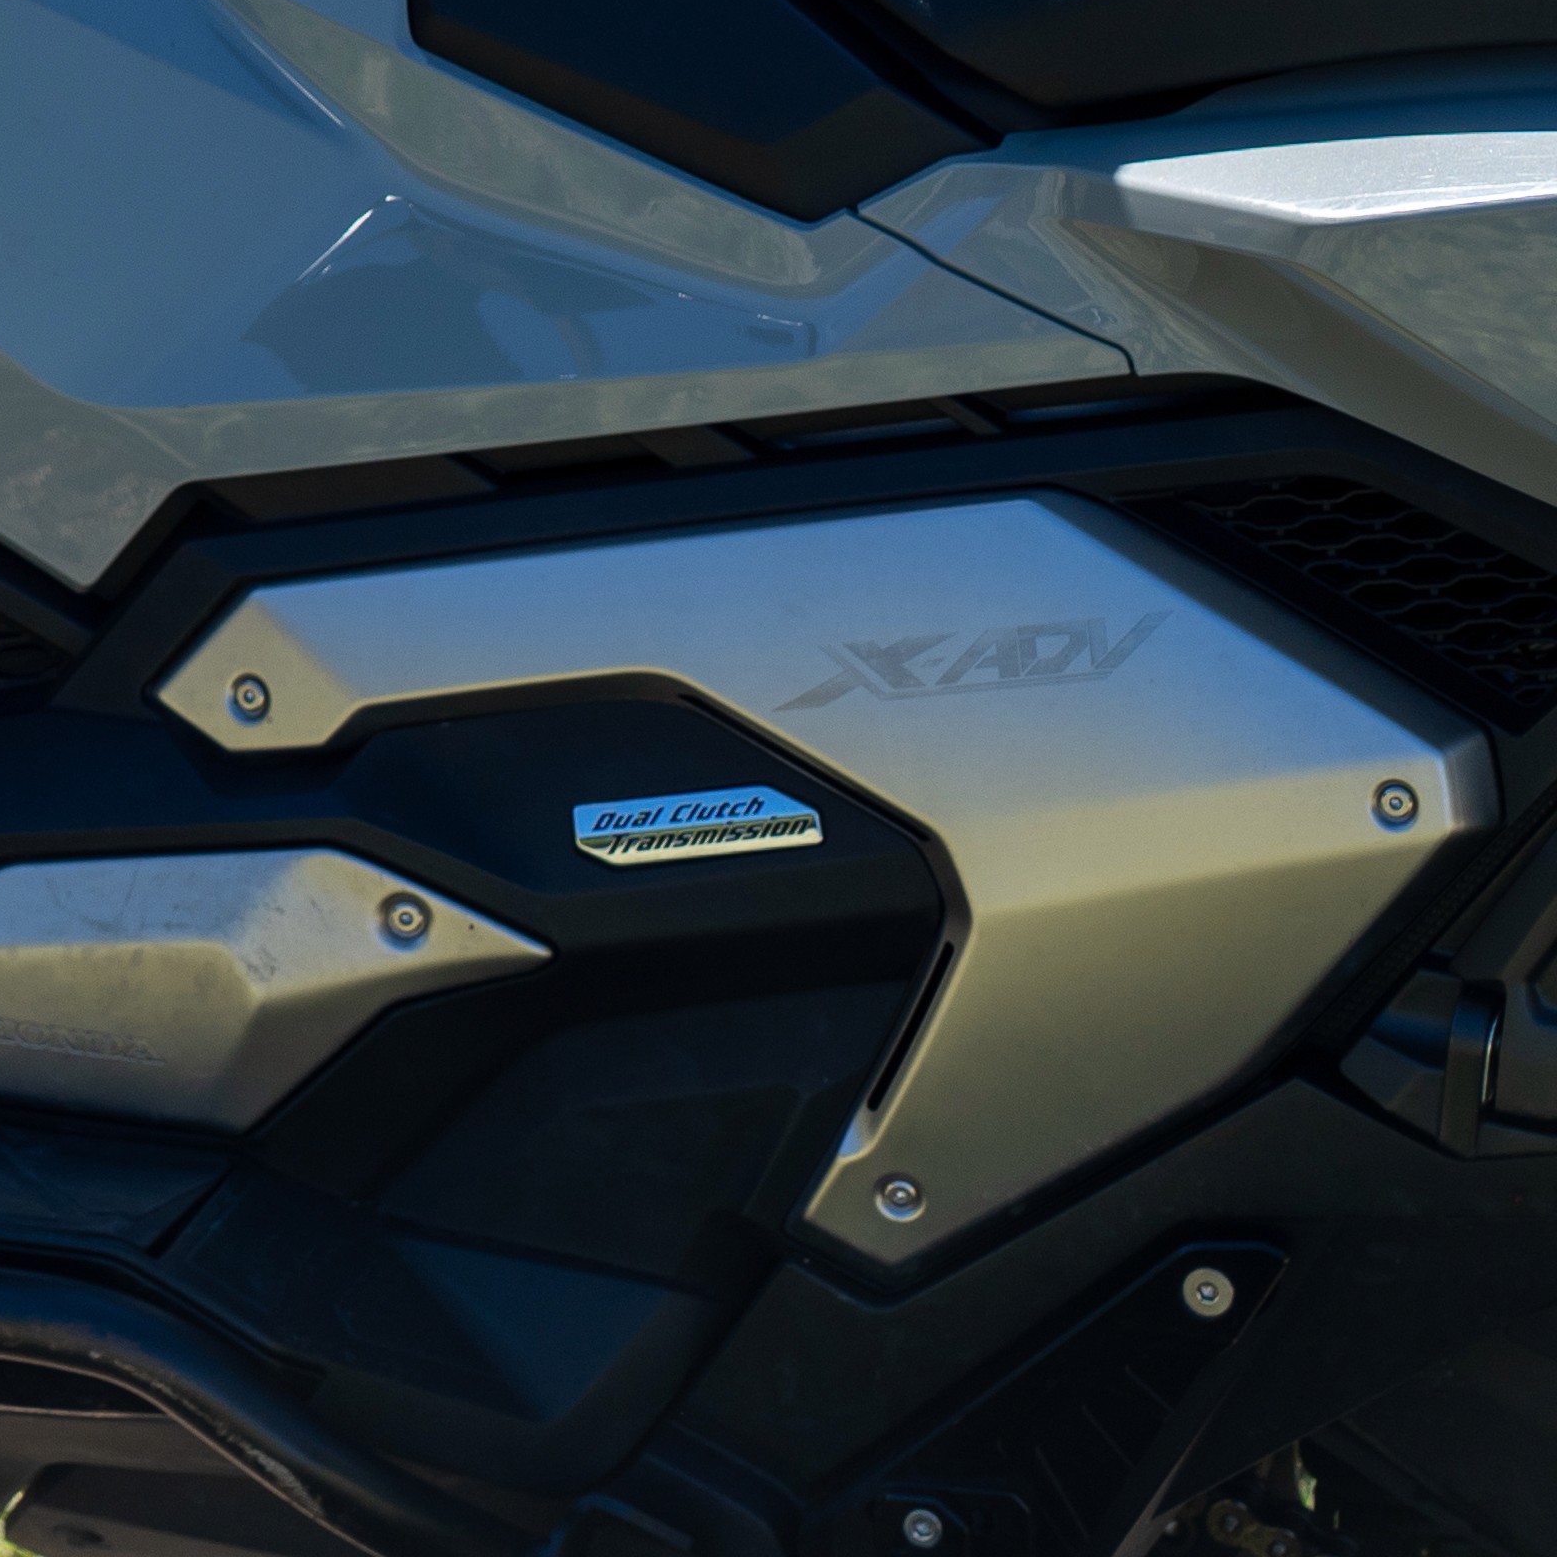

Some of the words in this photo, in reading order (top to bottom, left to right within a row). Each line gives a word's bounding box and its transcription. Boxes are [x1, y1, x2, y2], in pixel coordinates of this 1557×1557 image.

[772, 609, 1175, 712] X-ADV
[592, 805, 664, 832] Dual
[669, 796, 765, 824] Clutch
[606, 815, 812, 856] Transmission
